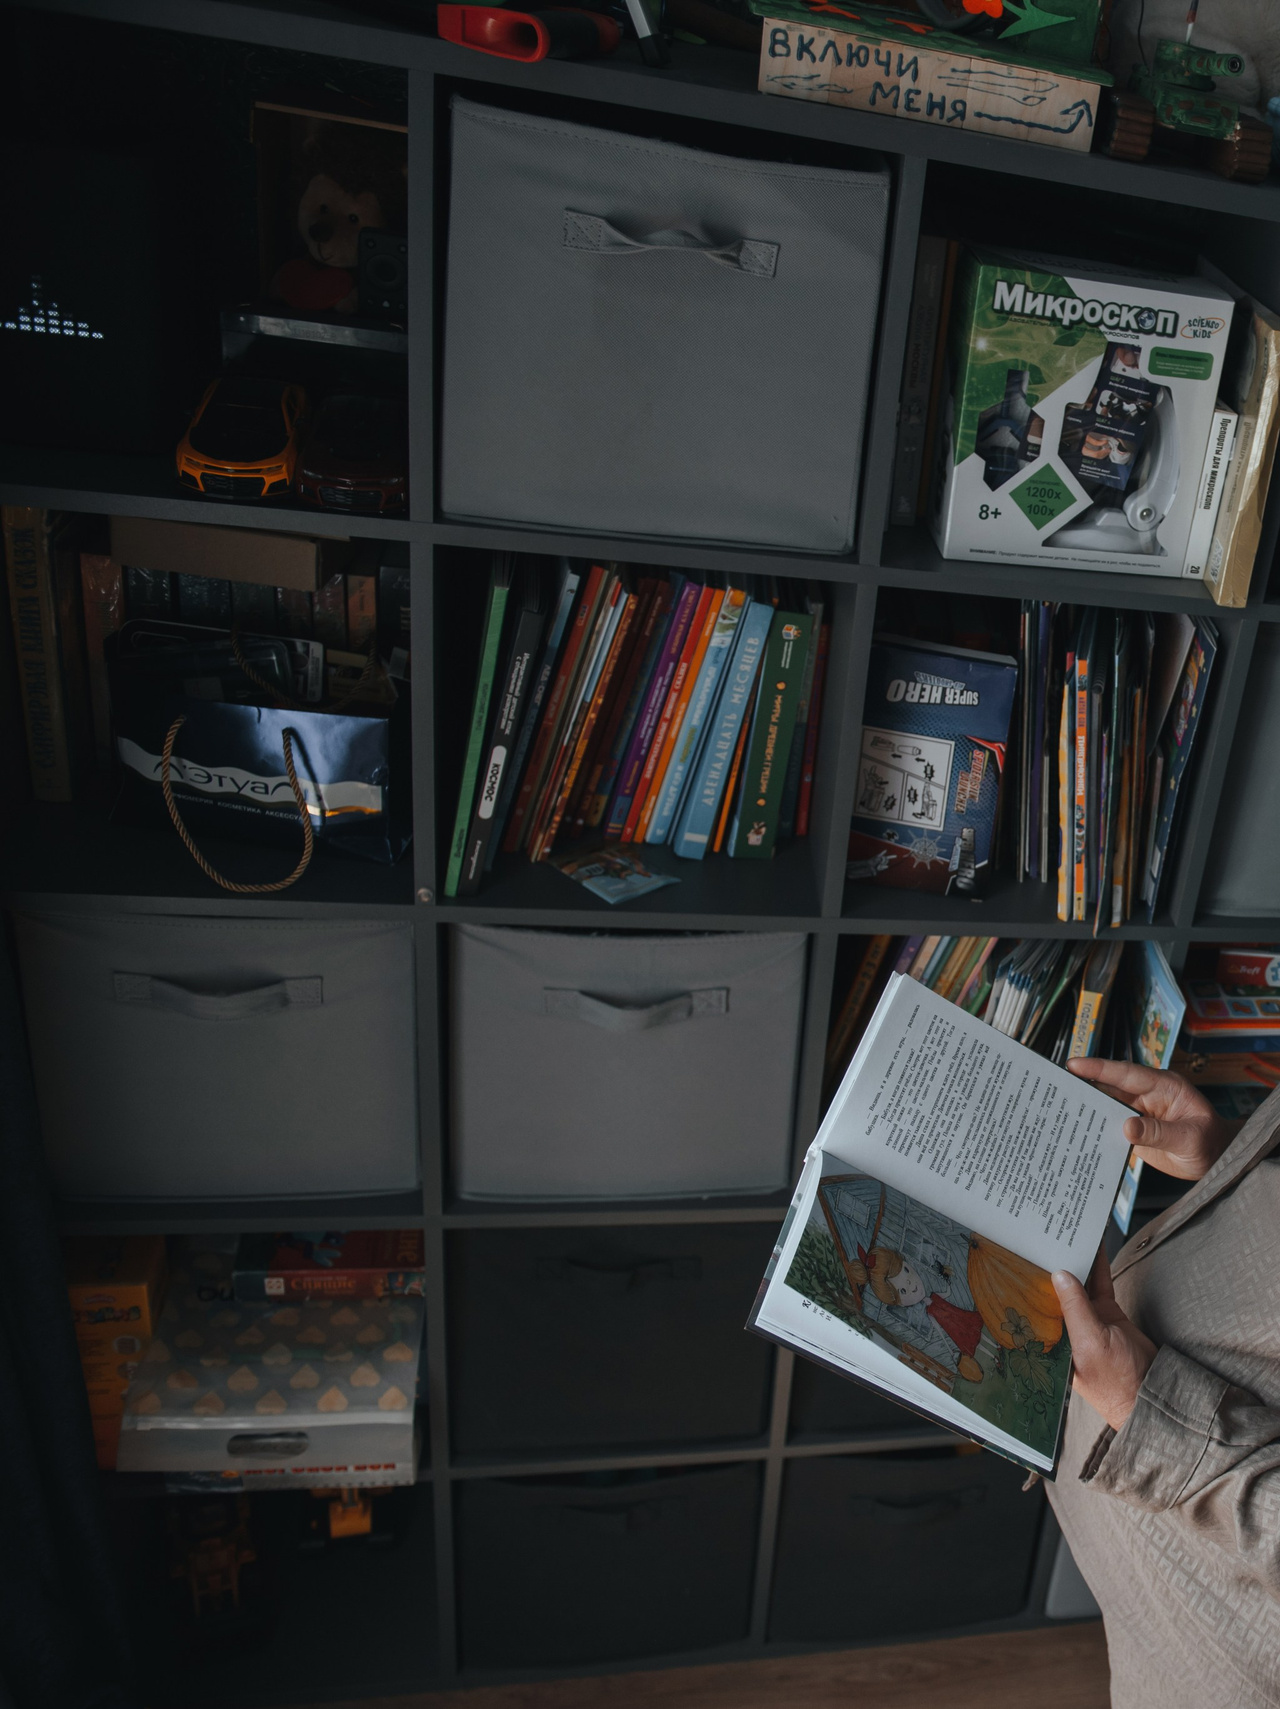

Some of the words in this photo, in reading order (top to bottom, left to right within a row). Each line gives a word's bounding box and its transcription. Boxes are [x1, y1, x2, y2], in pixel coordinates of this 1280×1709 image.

[769, 28, 918, 82] ВКЛЮЧИ
[869, 81, 967, 123] МЕНЯ
[993, 279, 1179, 338] Микроскоп
[1213, 417, 1231, 456] Препараты
[1210, 455, 1221, 469] для
[1025, 486, 1061, 500] 1200x
[1202, 469, 1218, 510] микроскопа
[978, 504, 1002, 520] 8+
[1027, 503, 1054, 516] 100x
[12, 528, 38, 590] СКАЗОК
[1189, 565, 1200, 574] 20
[17, 596, 44, 652] КНИГА
[769, 693, 784, 722] МИФЫ
[885, 678, 942, 704] HERO
[943, 687, 979, 705] SUPER
[701, 712, 738, 807] ДВЕНАДЦАТЬ
[731, 636, 760, 705] МЕСЯЦЕВ
[762, 723, 779, 760] ДРЕВНЕЙ
[485, 763, 500, 802] КОСМОС
[757, 762, 772, 794] ГРЕЦИИ
[217, 801, 261, 814] КОСМЕТИКА
[1075, 1002, 1094, 1042] ГОДОВОЙ
